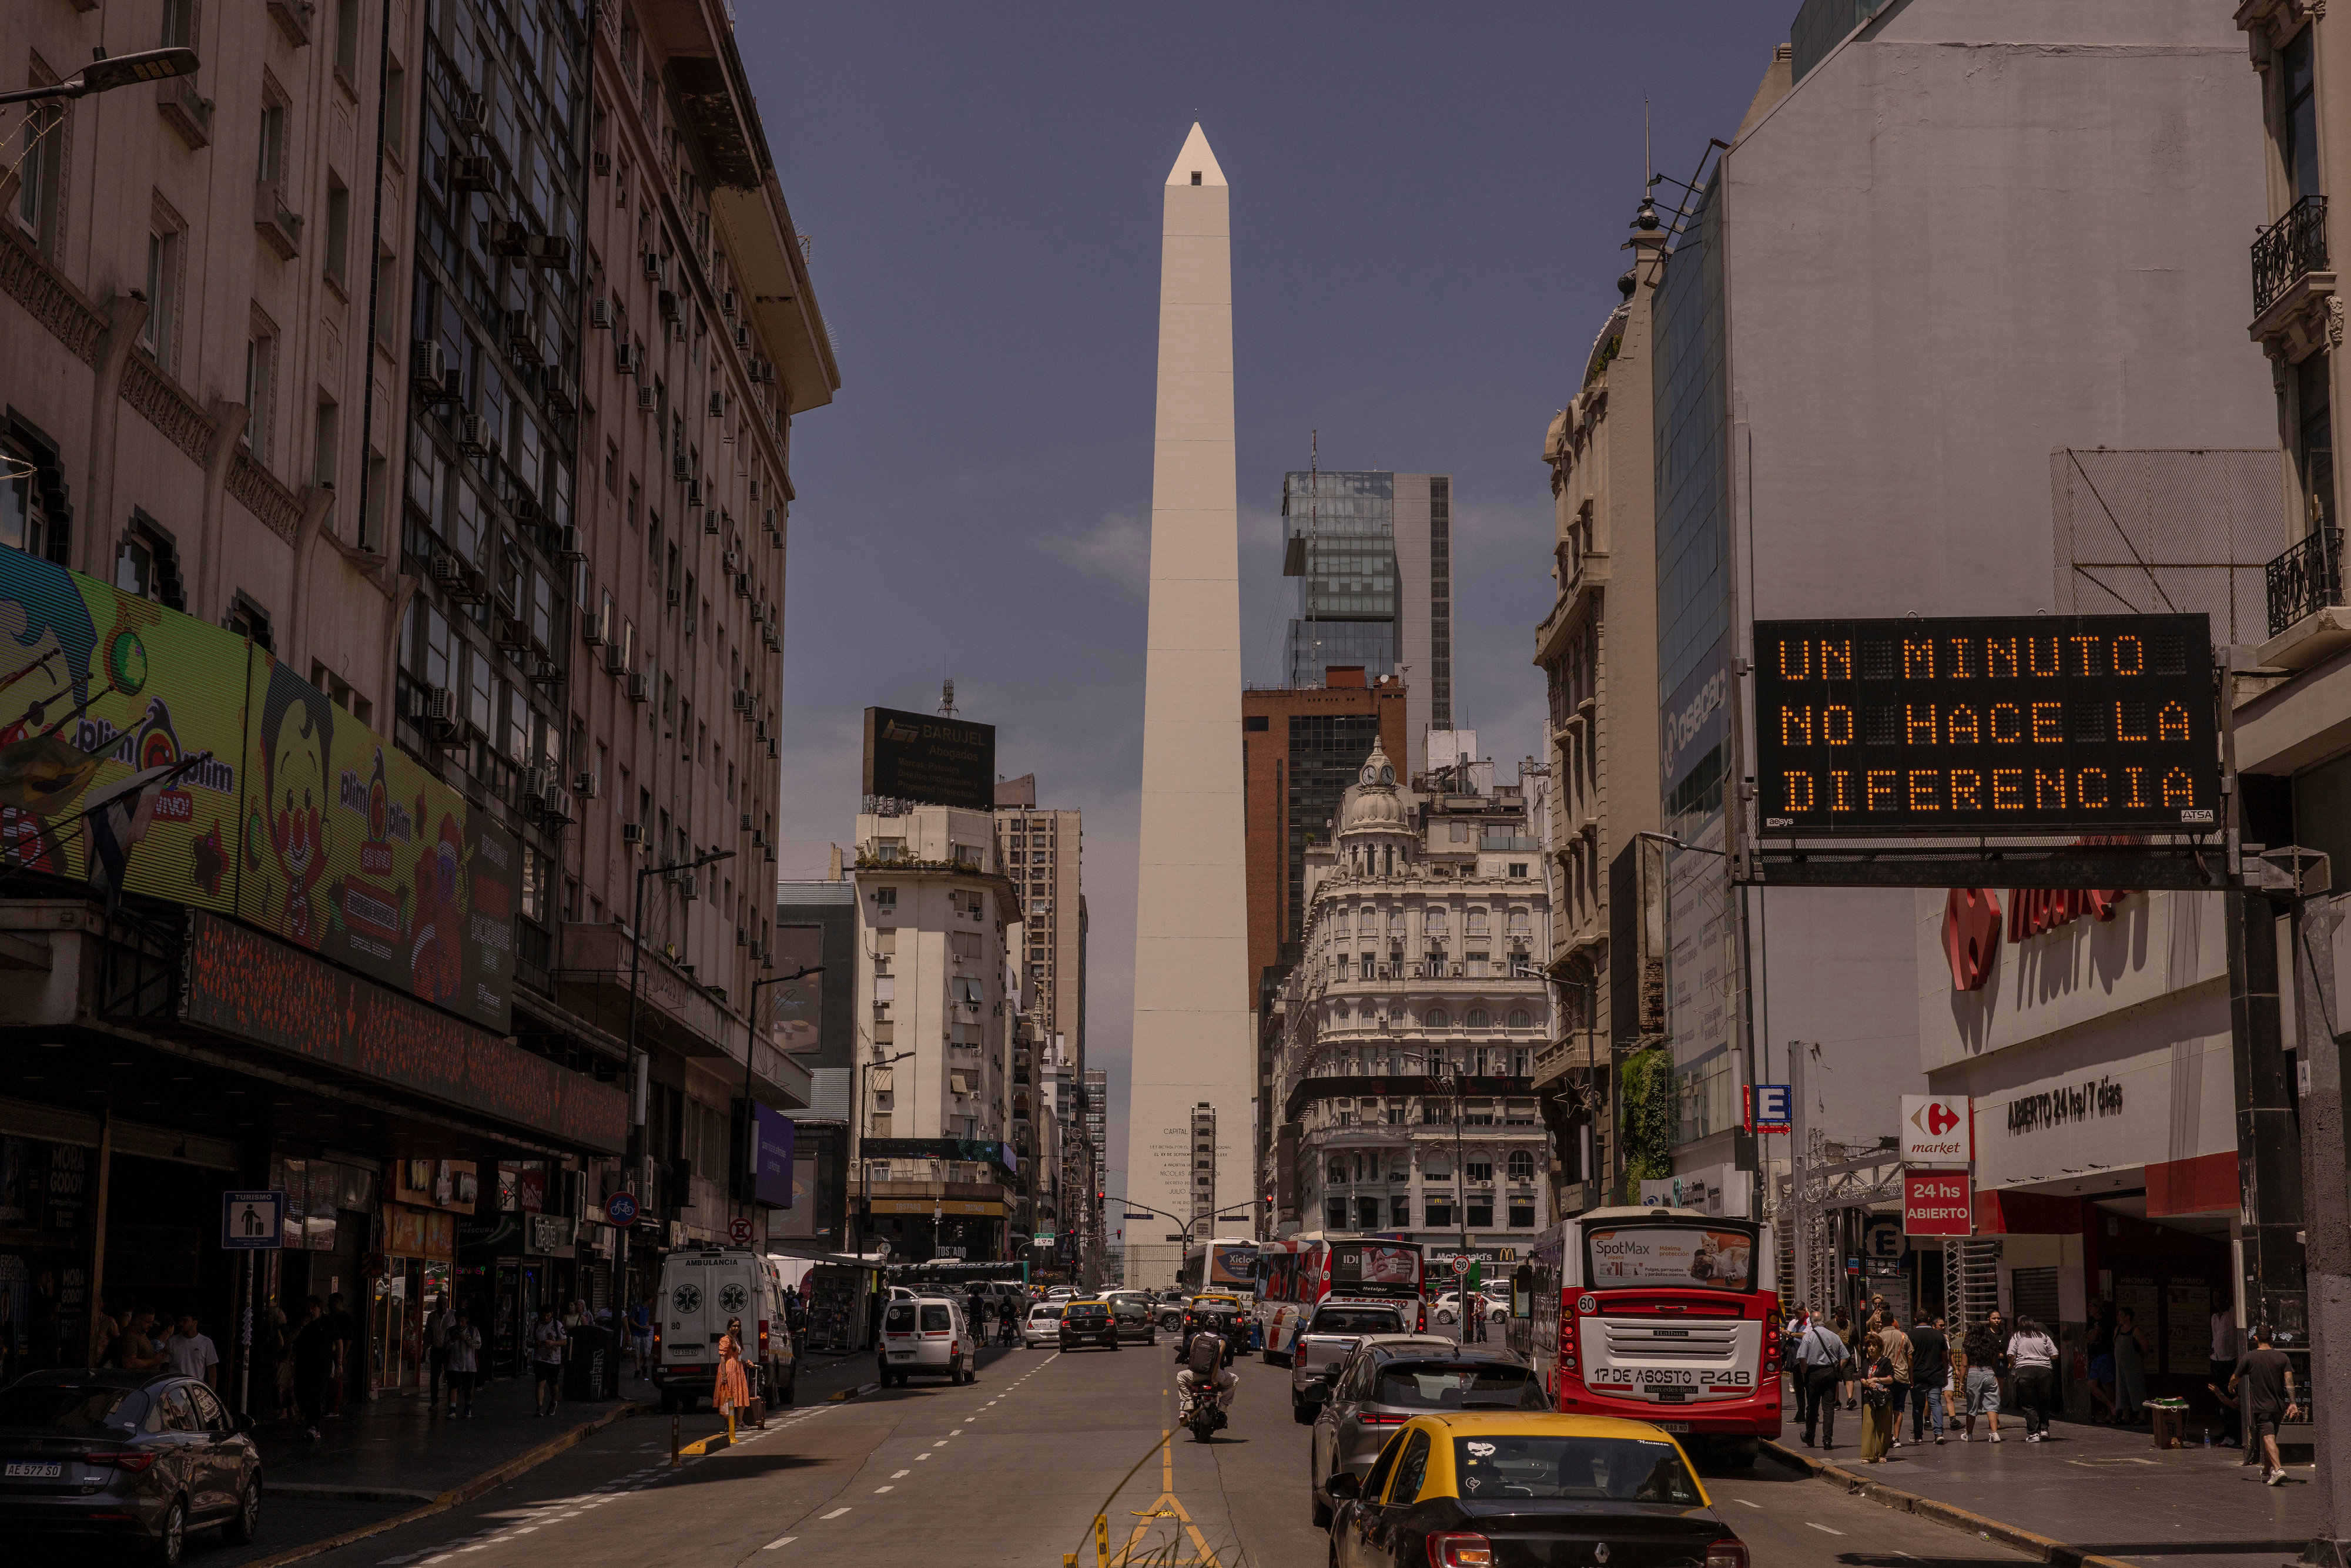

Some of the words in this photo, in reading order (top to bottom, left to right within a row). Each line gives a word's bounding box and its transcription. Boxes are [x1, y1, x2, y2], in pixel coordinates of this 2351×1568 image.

[1780, 639, 1852, 681] UN
[1904, 635, 2144, 679] MINUTO
[1781, 705, 1853, 746] NO
[1905, 701, 2064, 745] HACE
[2116, 700, 2190, 742] LA
[923, 724, 986, 746] BARUJEL
[929, 745, 979, 761] Abogados
[929, 762, 960, 774] Patentes
[897, 769, 927, 780] Diseños
[930, 774, 972, 787] Industriales
[897, 780, 935, 793] Propiedad
[937, 786, 974, 799] Intelectual
[1783, 766, 2195, 812] DIFERENCIA
[2182, 810, 2213, 819] ATSA
[1767, 818, 1794, 827] aesys
[1759, 1088, 1786, 1120] E
[2008, 1093, 2051, 1130] ABIERTO
[2054, 1089, 2068, 1118] 24
[2088, 1081, 2095, 1112] 7
[2098, 1076, 2122, 1110] días
[1911, 1142, 1961, 1154] market
[52, 1145, 85, 1171] MORA
[50, 1171, 85, 1194] GODOY
[1913, 1184, 1936, 1198] 24
[1940, 1183, 1961, 1198] hs
[896, 1203, 921, 1211] TOSTADO
[965, 1204, 984, 1212] TOSTADO
[1907, 1208, 1968, 1219] ABIERTO
[937, 1246, 966, 1259] TOSADO
[1596, 1241, 1650, 1257] SpotMax
[0, 1254, 20, 1268] ERGIO
[1343, 1255, 1359, 1264] IDI
[1436, 1253, 1492, 1261] McDnald's
[63, 1268, 84, 1286] MORA
[2171, 1277, 2205, 1285] PROMO!
[62, 1289, 84, 1304] GODOY
[1579, 1297, 1595, 1310] 60
[671, 1322, 681, 1330] 80
[1595, 1368, 1609, 1382] 17
[1613, 1369, 1631, 1382] DE
[1636, 1369, 1692, 1383] AGOSTO
[1700, 1371, 1750, 1385] 248
[1647, 1385, 1696, 1393] Mercedes-Benz
[8, 1466, 21, 1475] AE
[24, 1466, 43, 1475] 577
